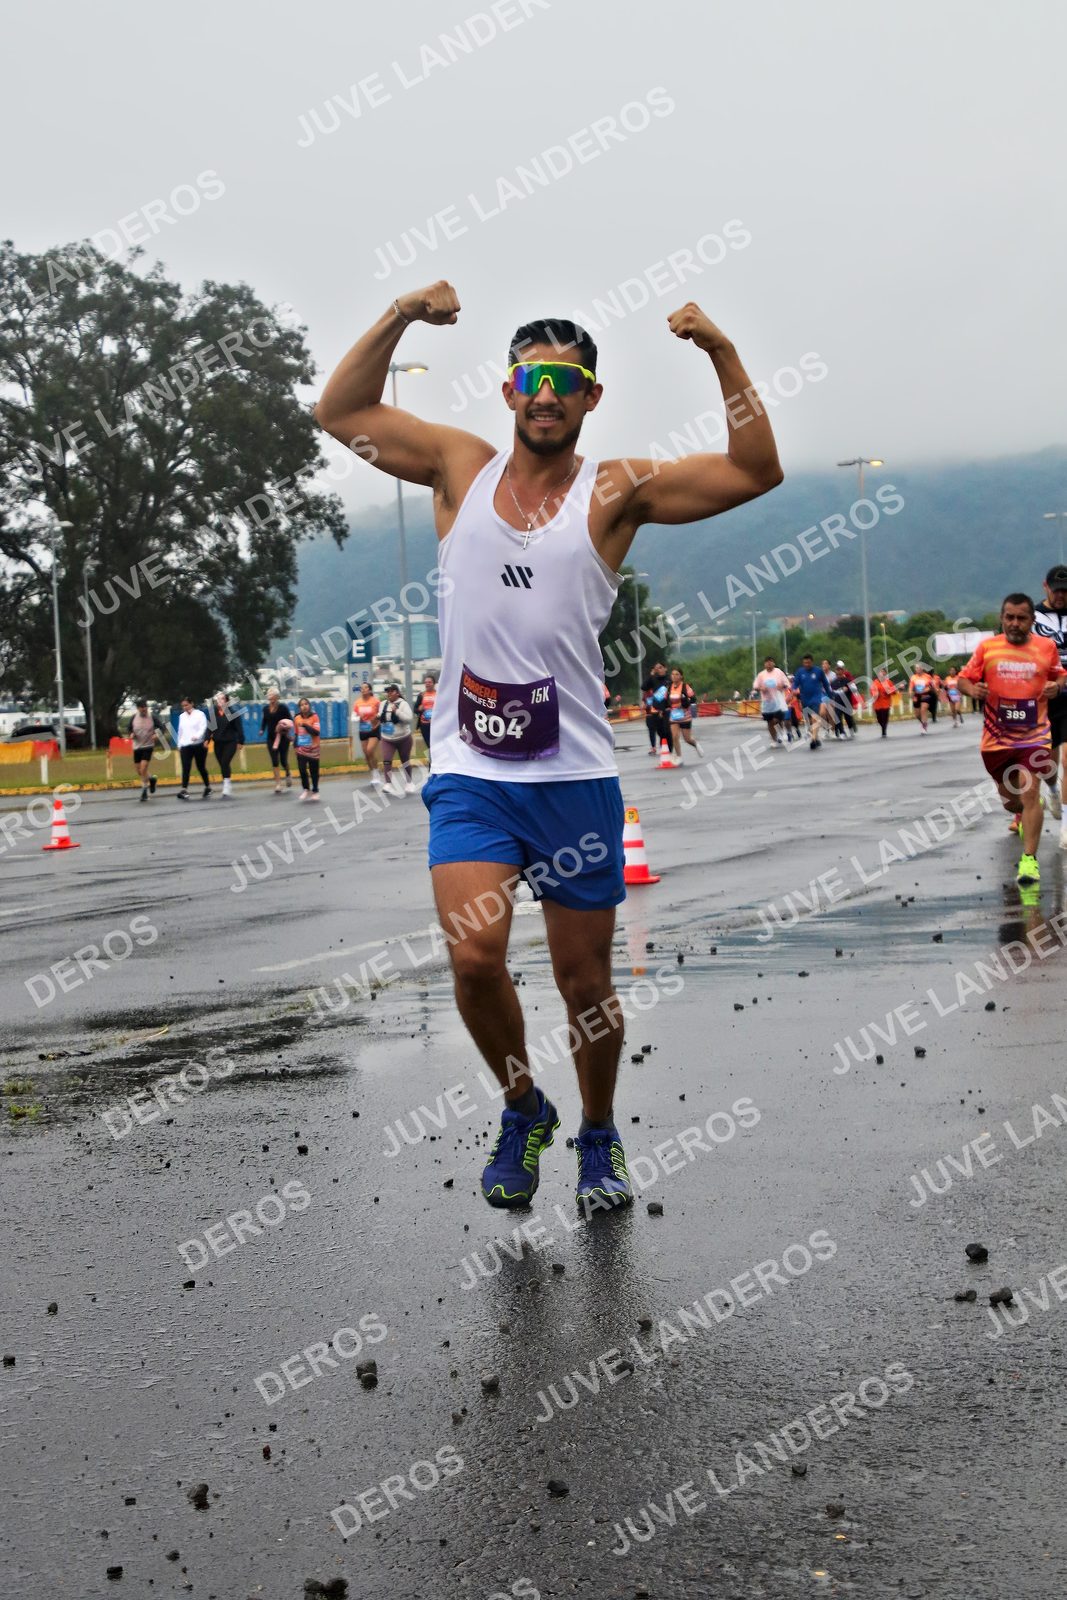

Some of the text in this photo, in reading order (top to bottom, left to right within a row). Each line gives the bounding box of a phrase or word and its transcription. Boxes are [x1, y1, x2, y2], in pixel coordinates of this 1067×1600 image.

[352, 639, 366, 658] E
[462, 673, 498, 700] CARRERA
[531, 686, 550, 704] 15K
[474, 710, 524, 739] 804
[1006, 710, 1027, 720] 389
